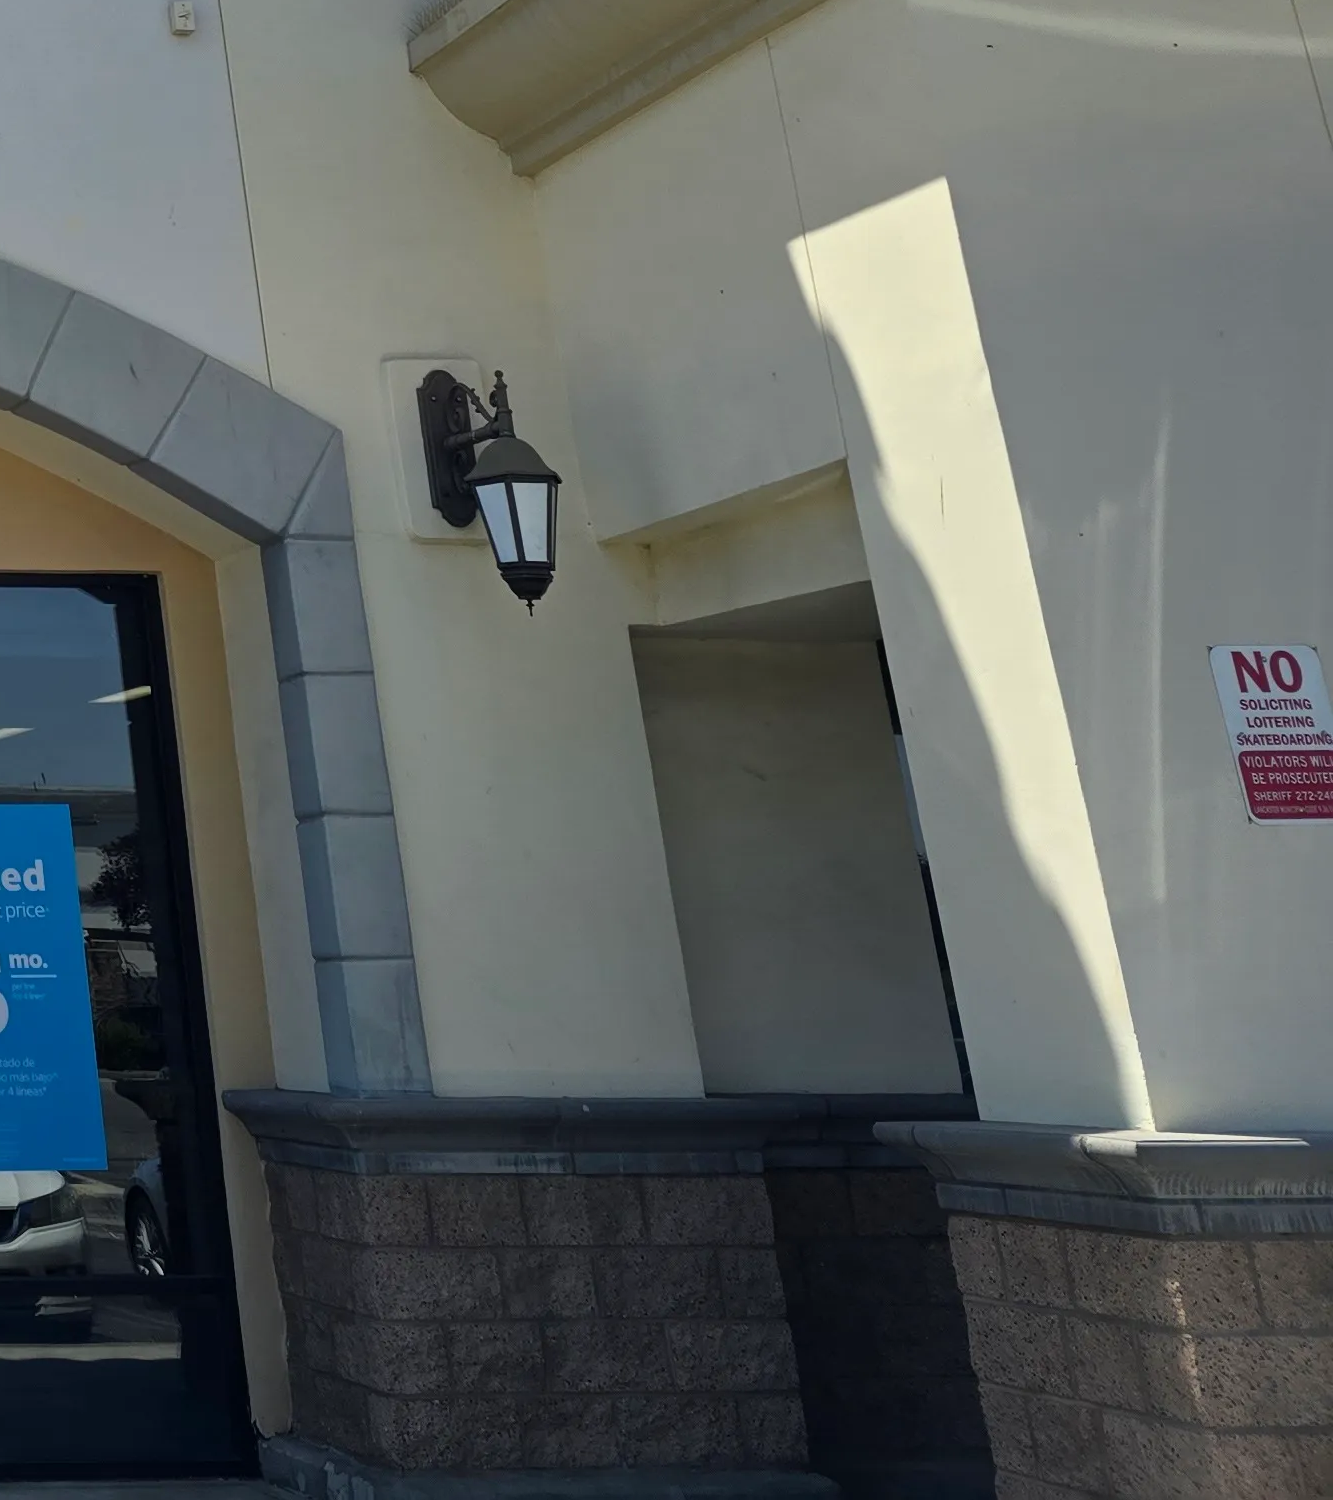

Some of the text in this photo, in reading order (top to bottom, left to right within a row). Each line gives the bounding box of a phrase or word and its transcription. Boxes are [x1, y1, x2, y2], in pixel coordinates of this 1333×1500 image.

[1231, 650, 1302, 693] NO
[1239, 699, 1313, 710] SOLICITING
[1246, 716, 1315, 728] LOITERING
[1236, 733, 1333, 746] SKATEBOARDING
[1242, 755, 1308, 768] VIOLATORS
[1251, 772, 1267, 785] BE
[1254, 791, 1292, 801] SHERIFF
[9, 953, 49, 969] mo.
[23, 1056, 35, 1068] de
